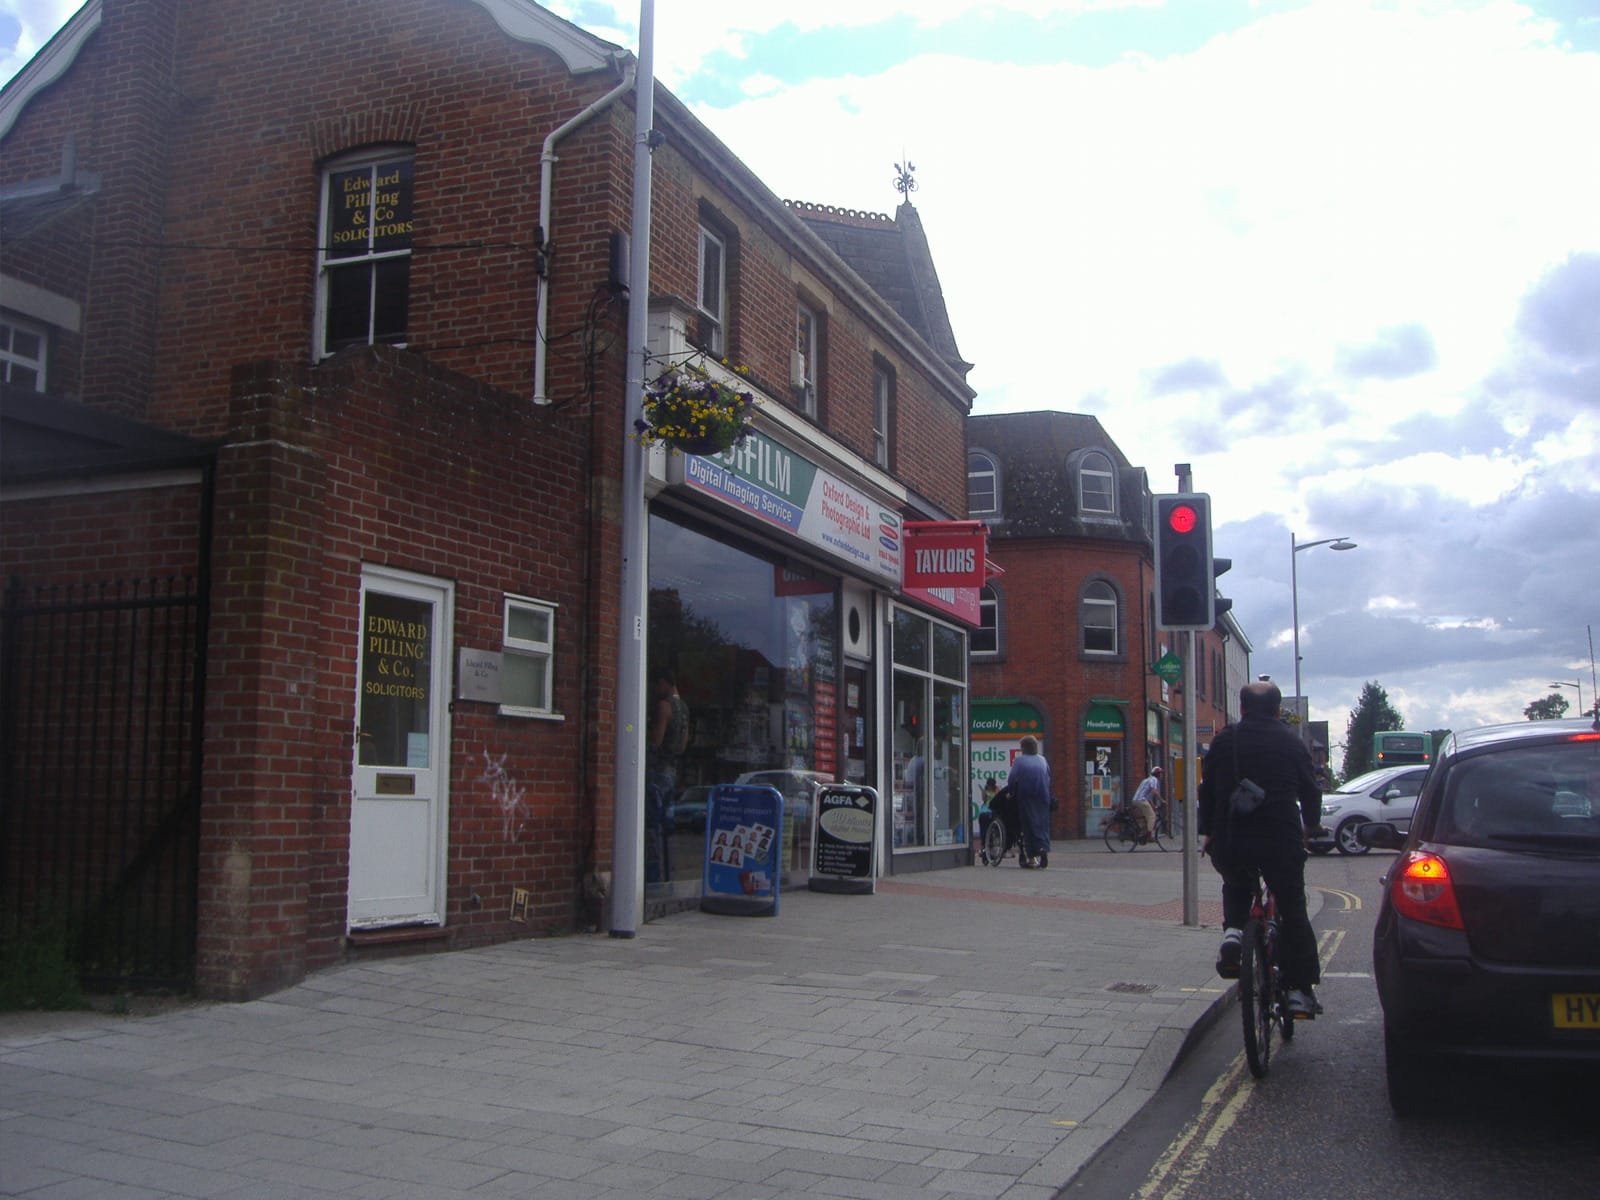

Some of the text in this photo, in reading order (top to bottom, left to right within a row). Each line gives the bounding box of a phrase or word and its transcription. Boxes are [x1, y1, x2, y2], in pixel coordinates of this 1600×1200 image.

[344, 170, 400, 192] Edward
[345, 191, 400, 209] Pilling
[352, 206, 394, 225] & Co
[333, 220, 414, 243] SOLICITORS
[690, 458, 792, 522] Digital Imaging Service
[822, 480, 844, 506] Oxford
[845, 493, 865, 520] Design
[821, 499, 861, 535] Photographic
[861, 521, 871, 540] Ltd
[914, 547, 976, 574] TAYLORS
[367, 615, 427, 640] EDWARD
[369, 636, 425, 660] PILLING
[377, 658, 416, 679] & Co.
[365, 681, 426, 700] SOLICITORS
[972, 719, 1005, 731] locally
[1086, 719, 1121, 730] Headington
[971, 746, 1007, 762] ndis
[823, 794, 854, 806] AGFA
